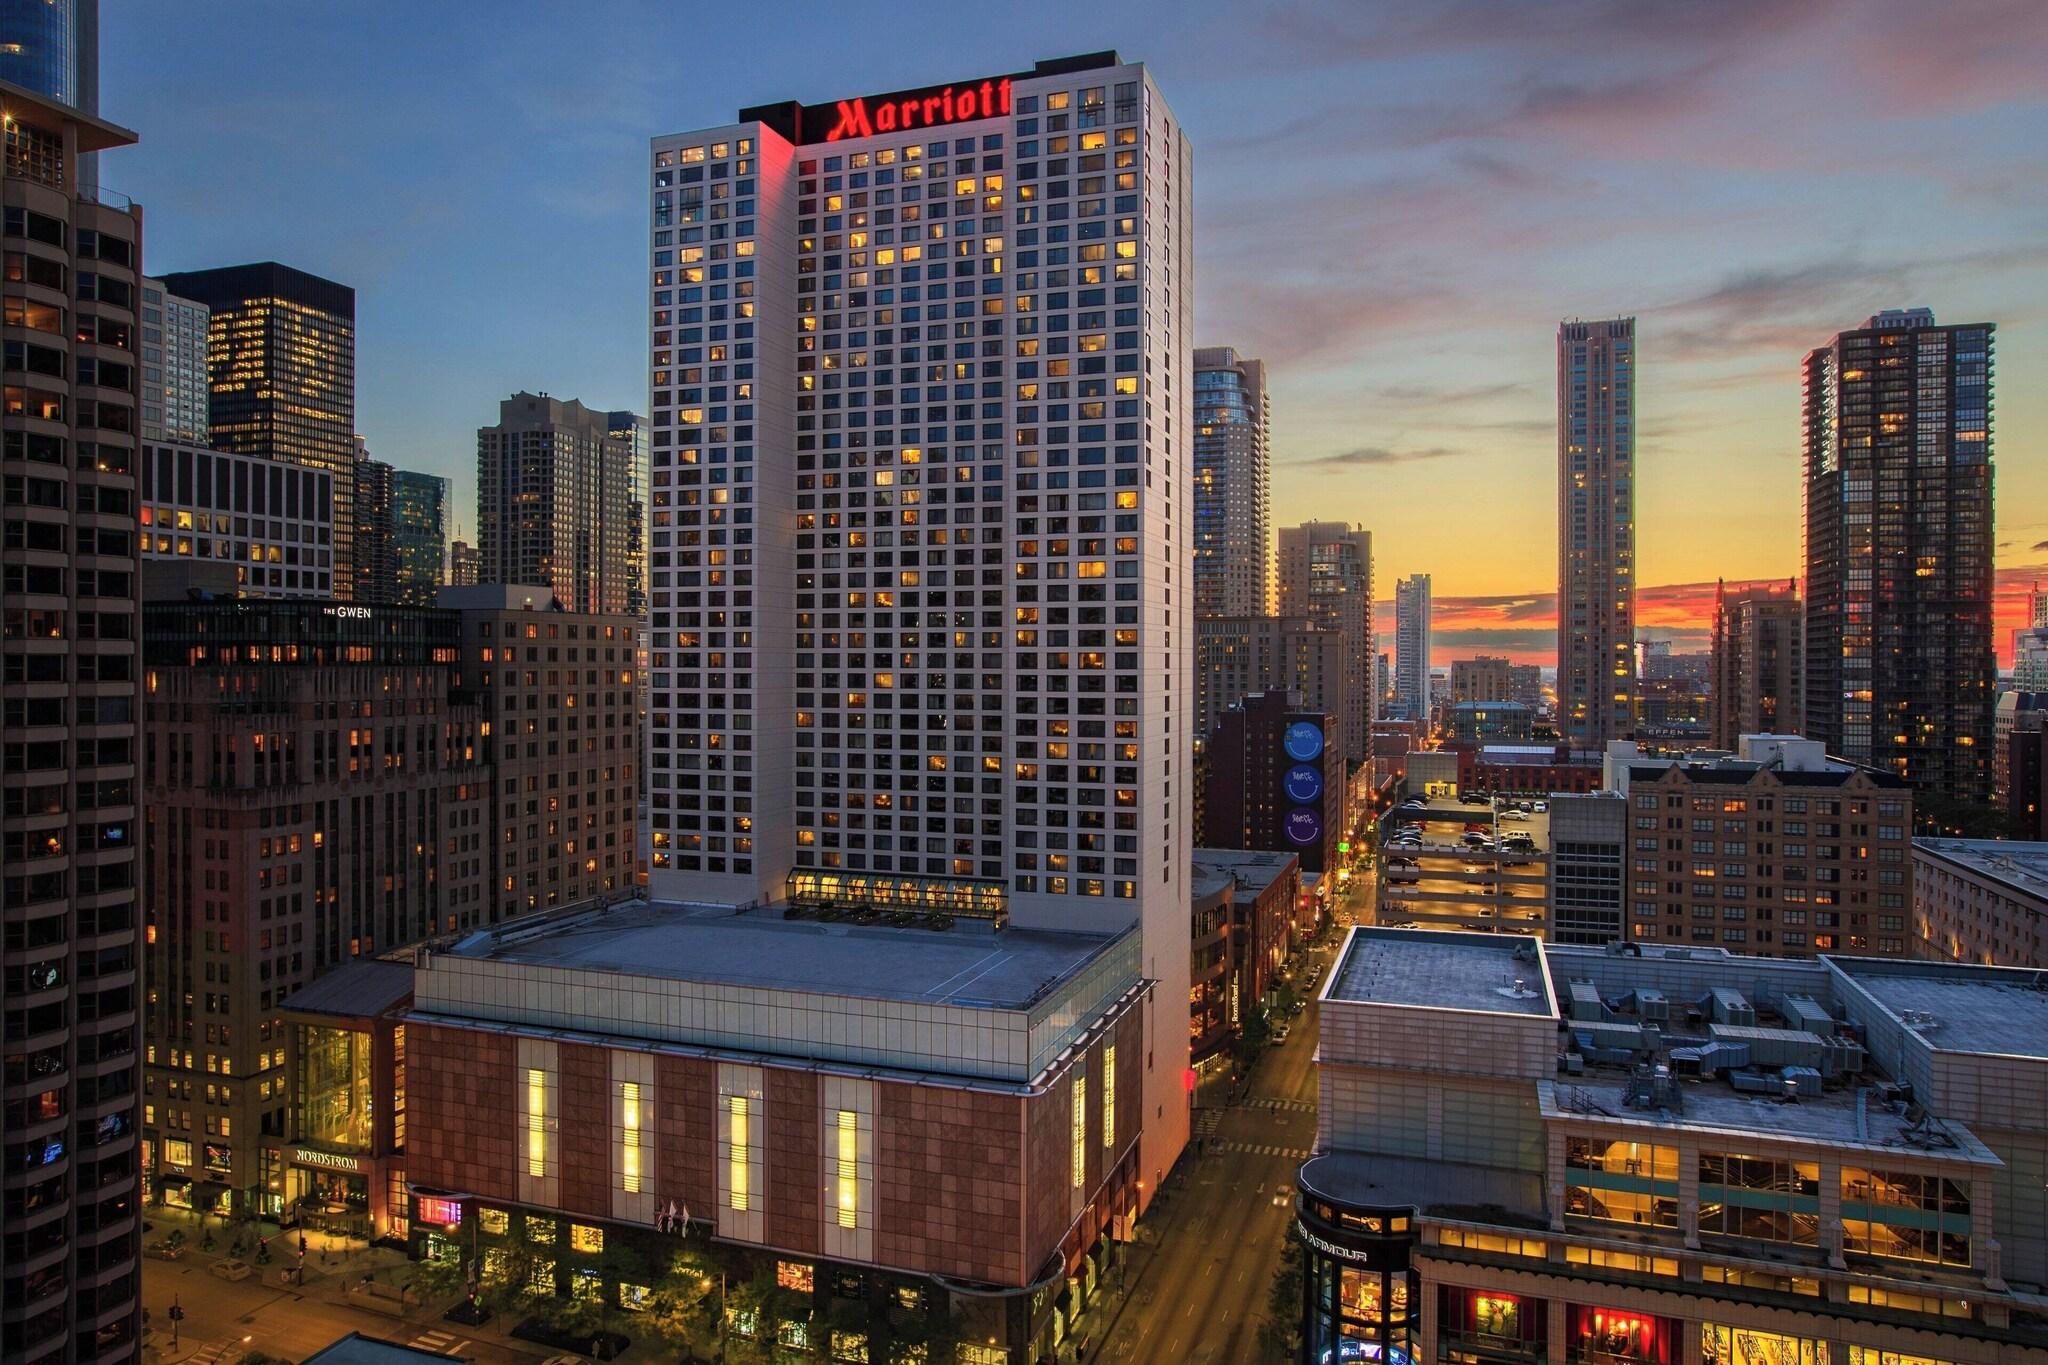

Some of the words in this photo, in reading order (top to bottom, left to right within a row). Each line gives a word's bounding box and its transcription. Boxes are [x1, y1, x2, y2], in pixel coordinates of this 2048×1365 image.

[827, 77, 1012, 142] Marriott
[337, 606, 371, 618] GWEN
[297, 1150, 358, 1171] NORDSTROM
[1309, 1233, 1367, 1262] ARMOUR
